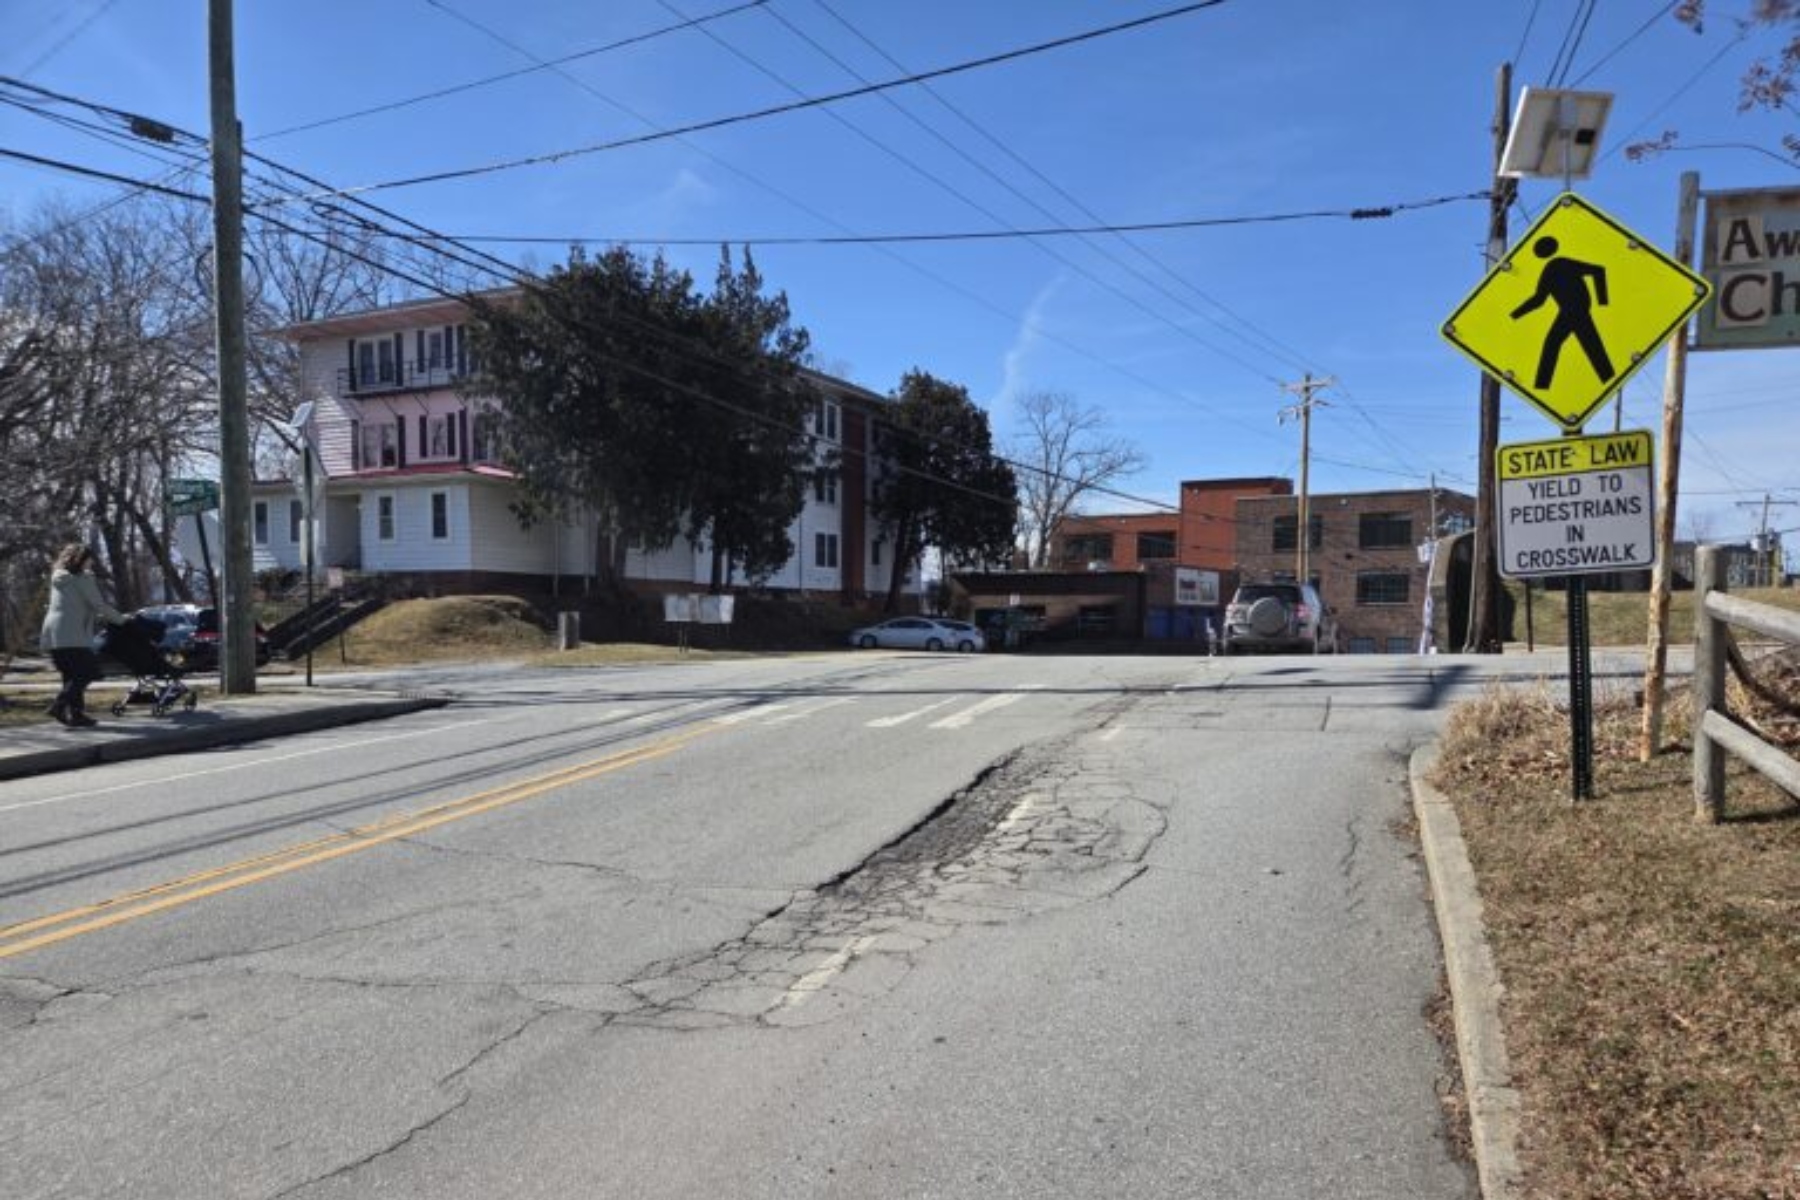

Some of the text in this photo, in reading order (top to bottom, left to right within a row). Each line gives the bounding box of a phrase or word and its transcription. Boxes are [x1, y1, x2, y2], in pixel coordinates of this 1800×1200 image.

[1722, 219, 1800, 261] Aw
[1509, 441, 1639, 474] STATE LAW
[1528, 473, 1622, 499] YIELD TO
[1510, 497, 1642, 524] PEDESTRIANS
[1566, 525, 1584, 543] IN
[1517, 543, 1637, 569] CROSSWALK
